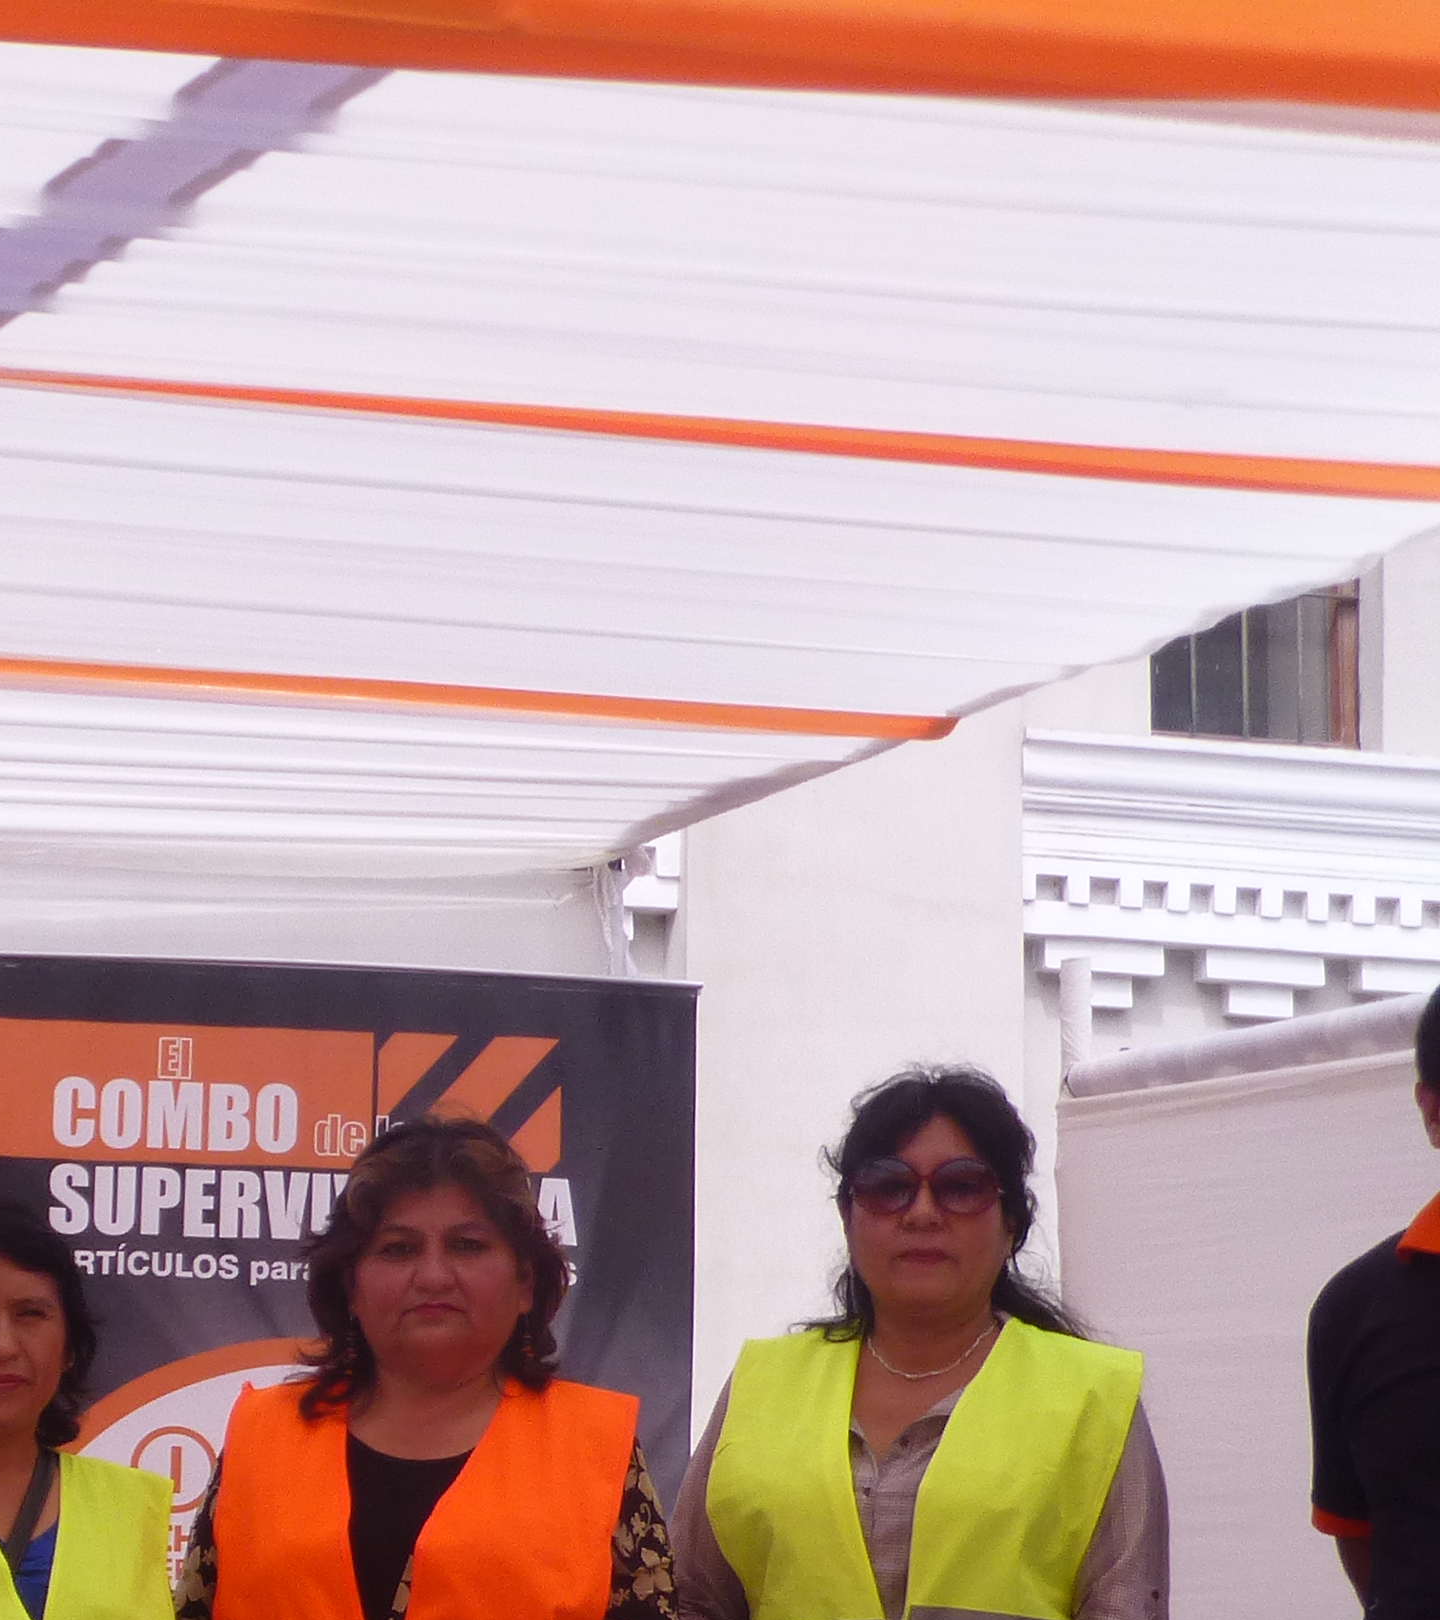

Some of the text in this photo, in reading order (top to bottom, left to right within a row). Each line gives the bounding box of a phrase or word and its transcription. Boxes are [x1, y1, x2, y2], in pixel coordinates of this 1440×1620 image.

[157, 1036, 194, 1080] El
[52, 1076, 299, 1154] COMBO
[314, 1113, 367, 1157] de
[48, 1163, 578, 1246] SUPERVIA
[74, 1243, 240, 1280] RTÍCULOS
